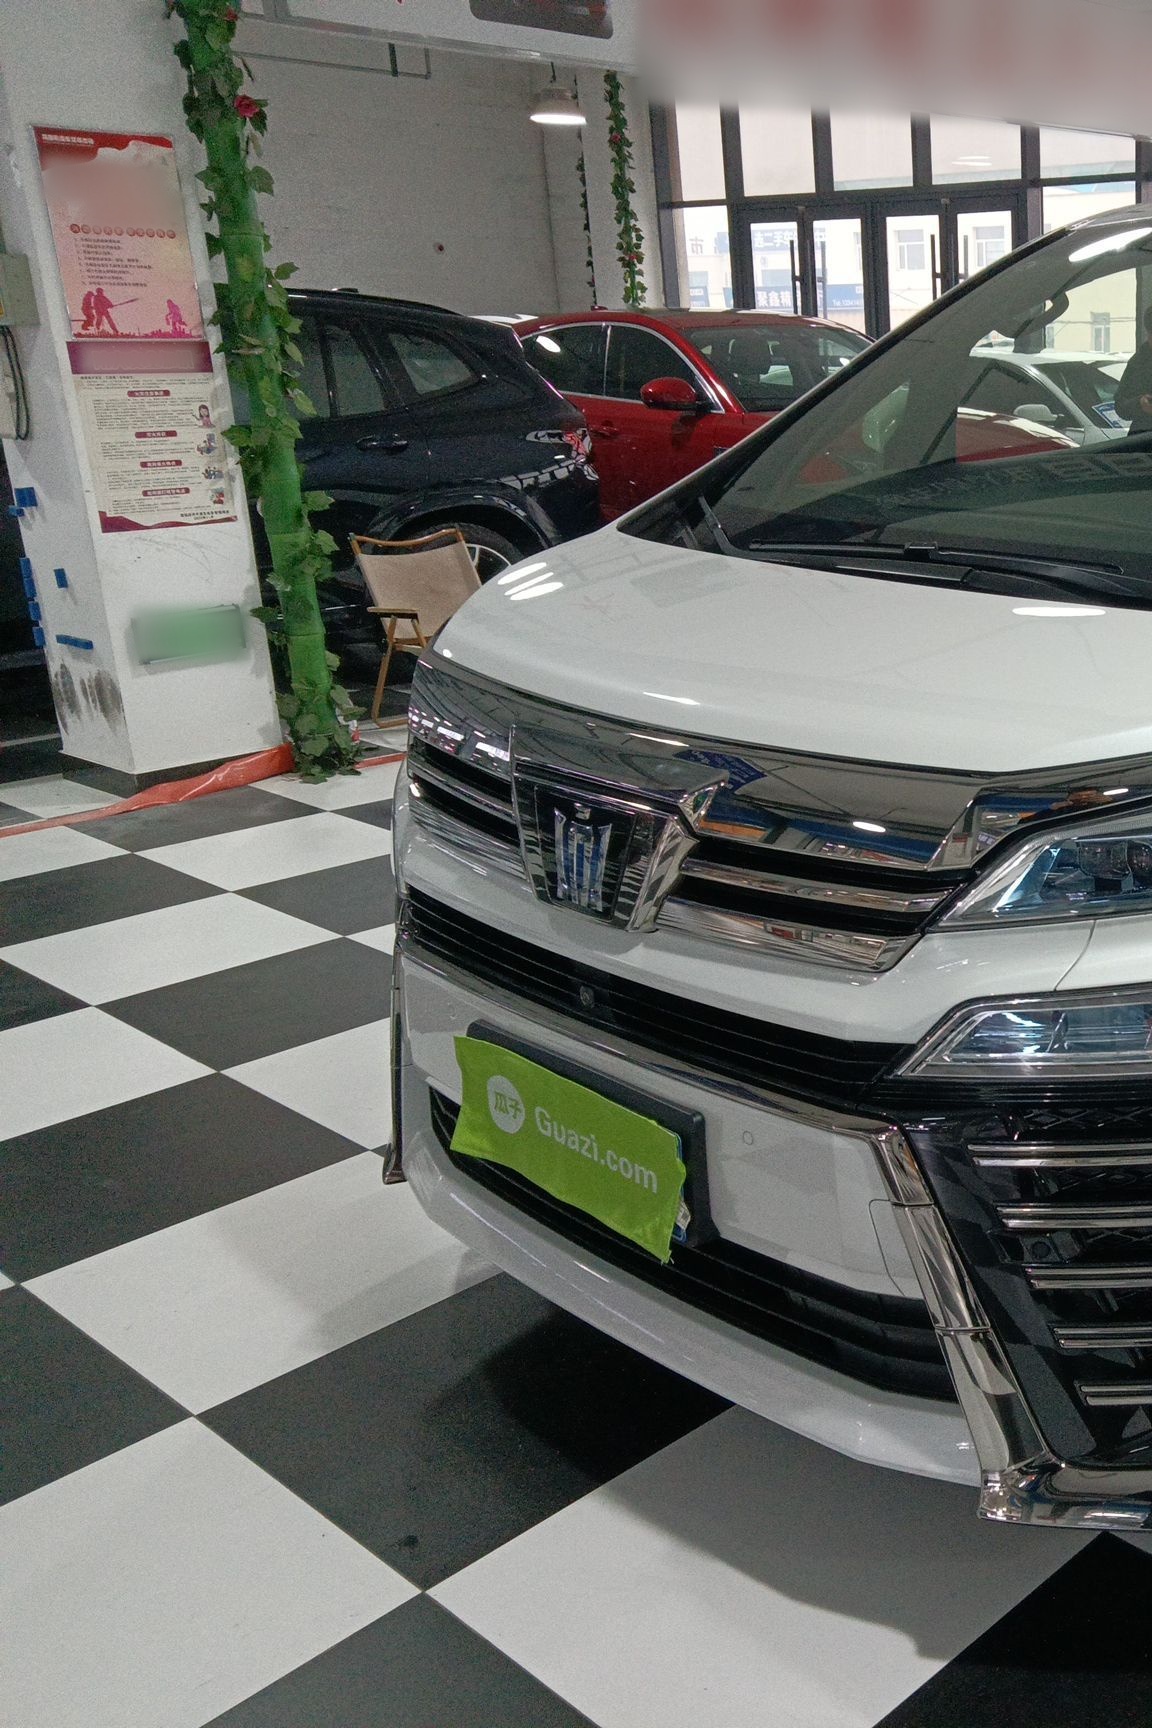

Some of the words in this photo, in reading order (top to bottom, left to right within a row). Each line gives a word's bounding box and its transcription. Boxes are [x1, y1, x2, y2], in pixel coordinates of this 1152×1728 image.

[689, 236, 704, 255] 市
[494, 1091, 524, 1119] 瓜子
[534, 1106, 658, 1193] Guazi.com
